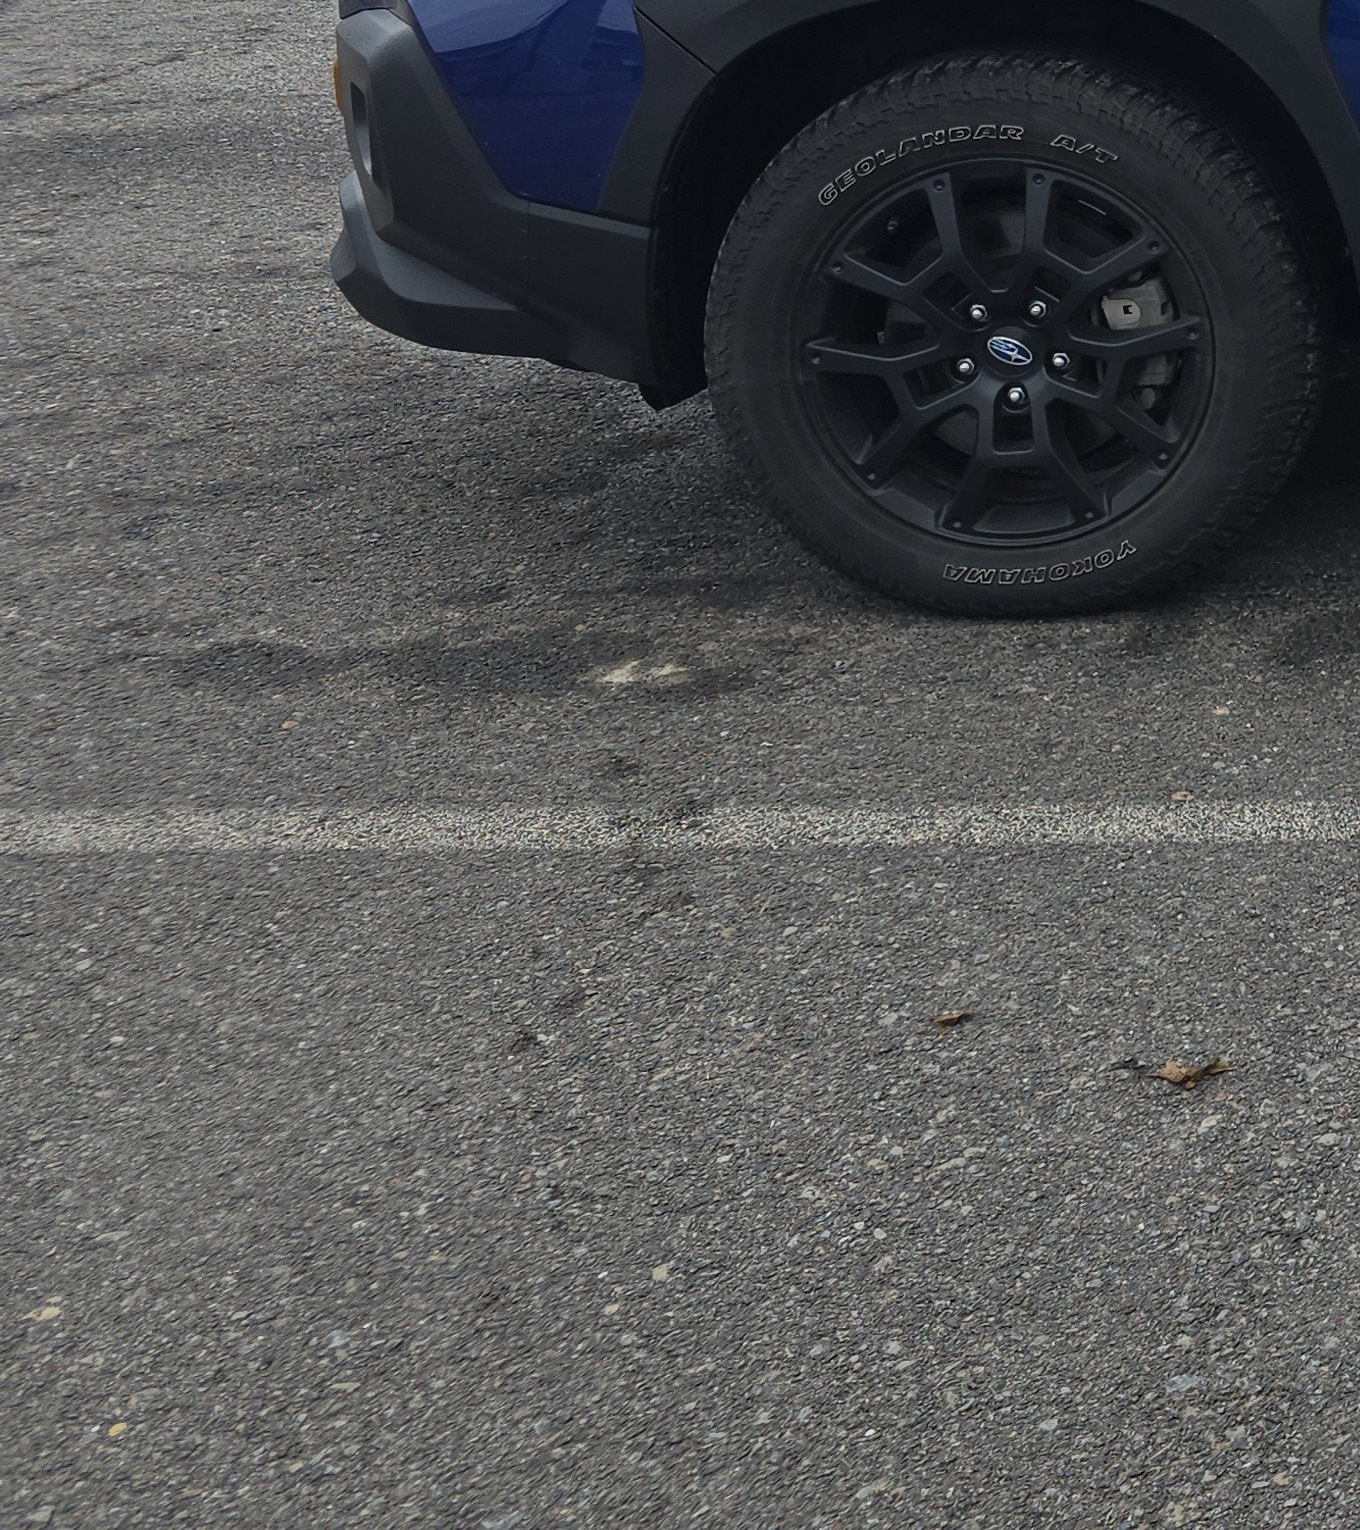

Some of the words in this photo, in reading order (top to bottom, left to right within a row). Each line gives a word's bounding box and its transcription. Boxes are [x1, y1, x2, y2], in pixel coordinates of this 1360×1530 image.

[818, 124, 1024, 206] GEOLANDAR
[1050, 134, 1119, 164] A/T
[942, 540, 1137, 584] YOKOHAMA
